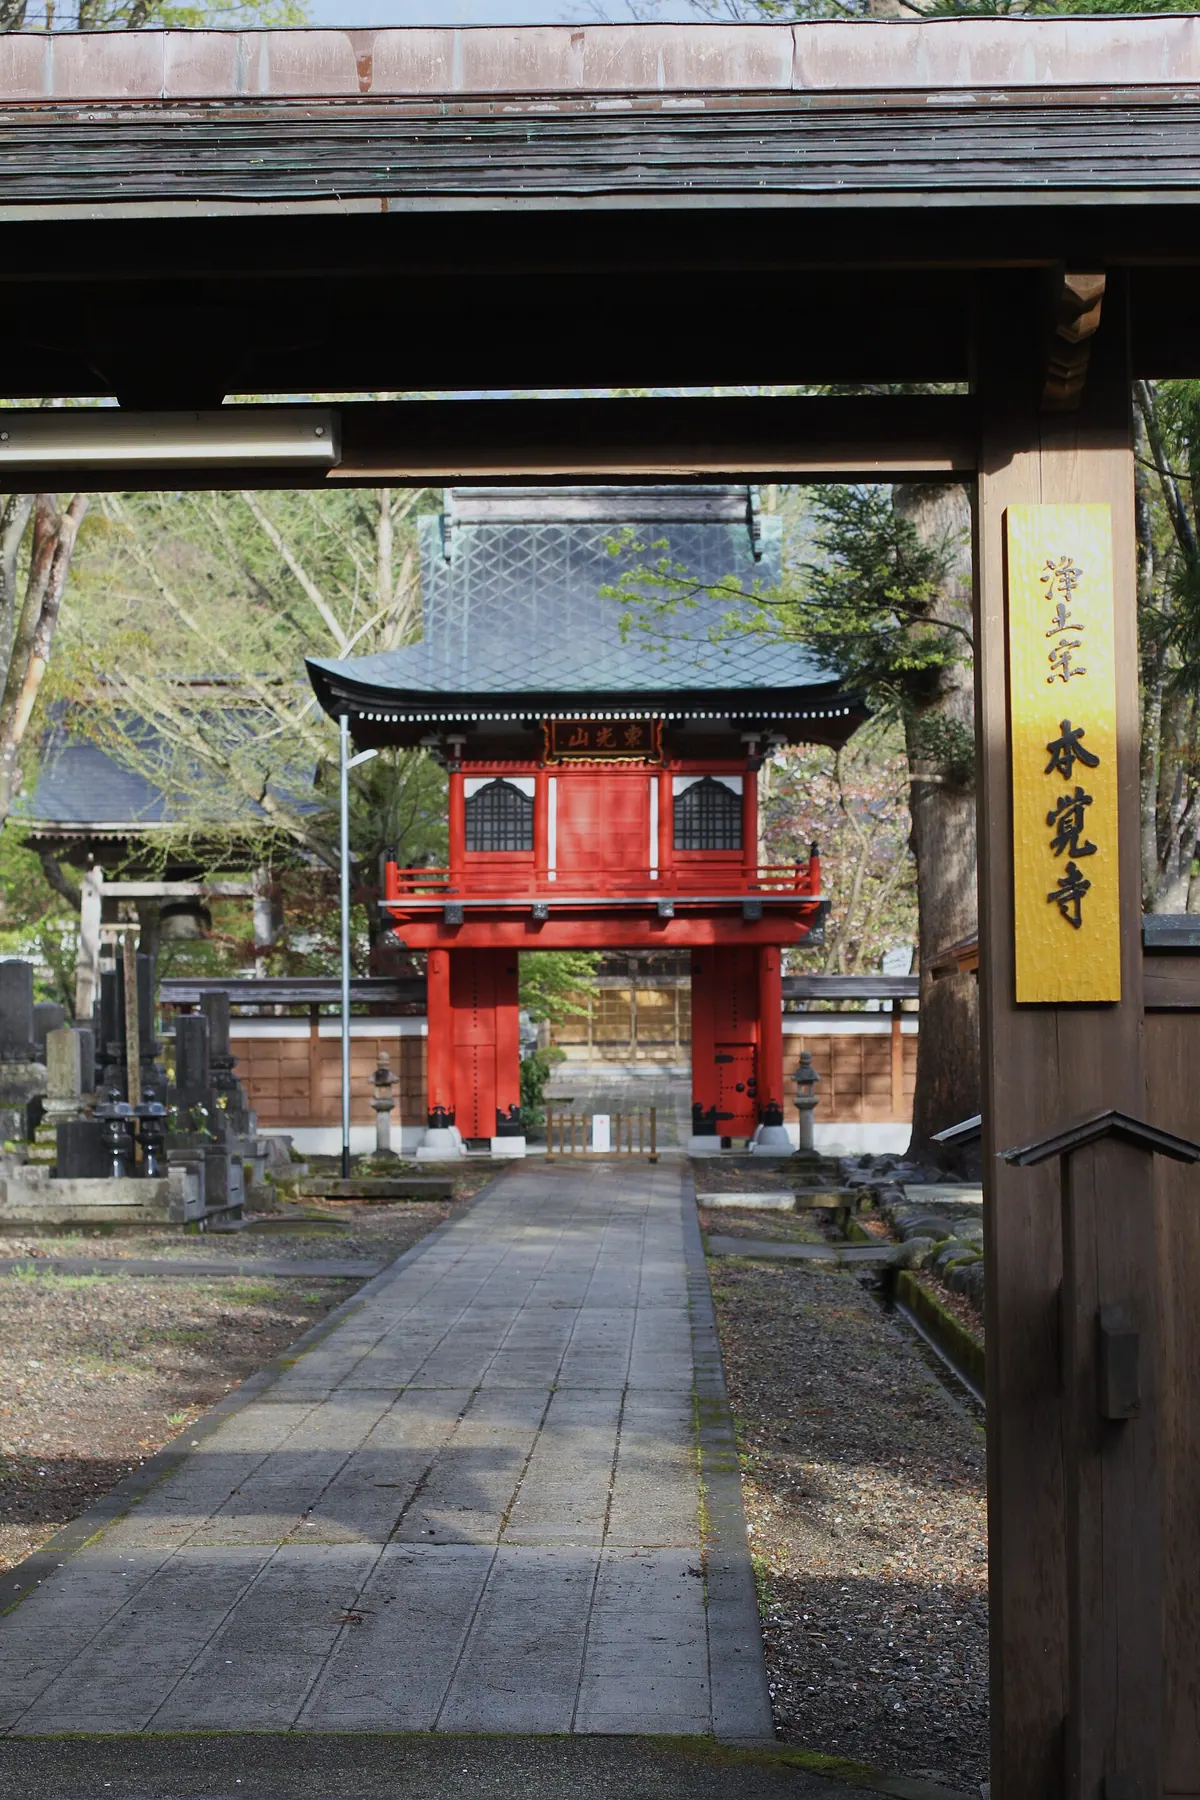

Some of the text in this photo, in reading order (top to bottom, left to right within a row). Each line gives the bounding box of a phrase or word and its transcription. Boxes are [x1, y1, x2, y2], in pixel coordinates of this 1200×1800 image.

[1040, 555, 1100, 929] 浄土宗 本覚寺
